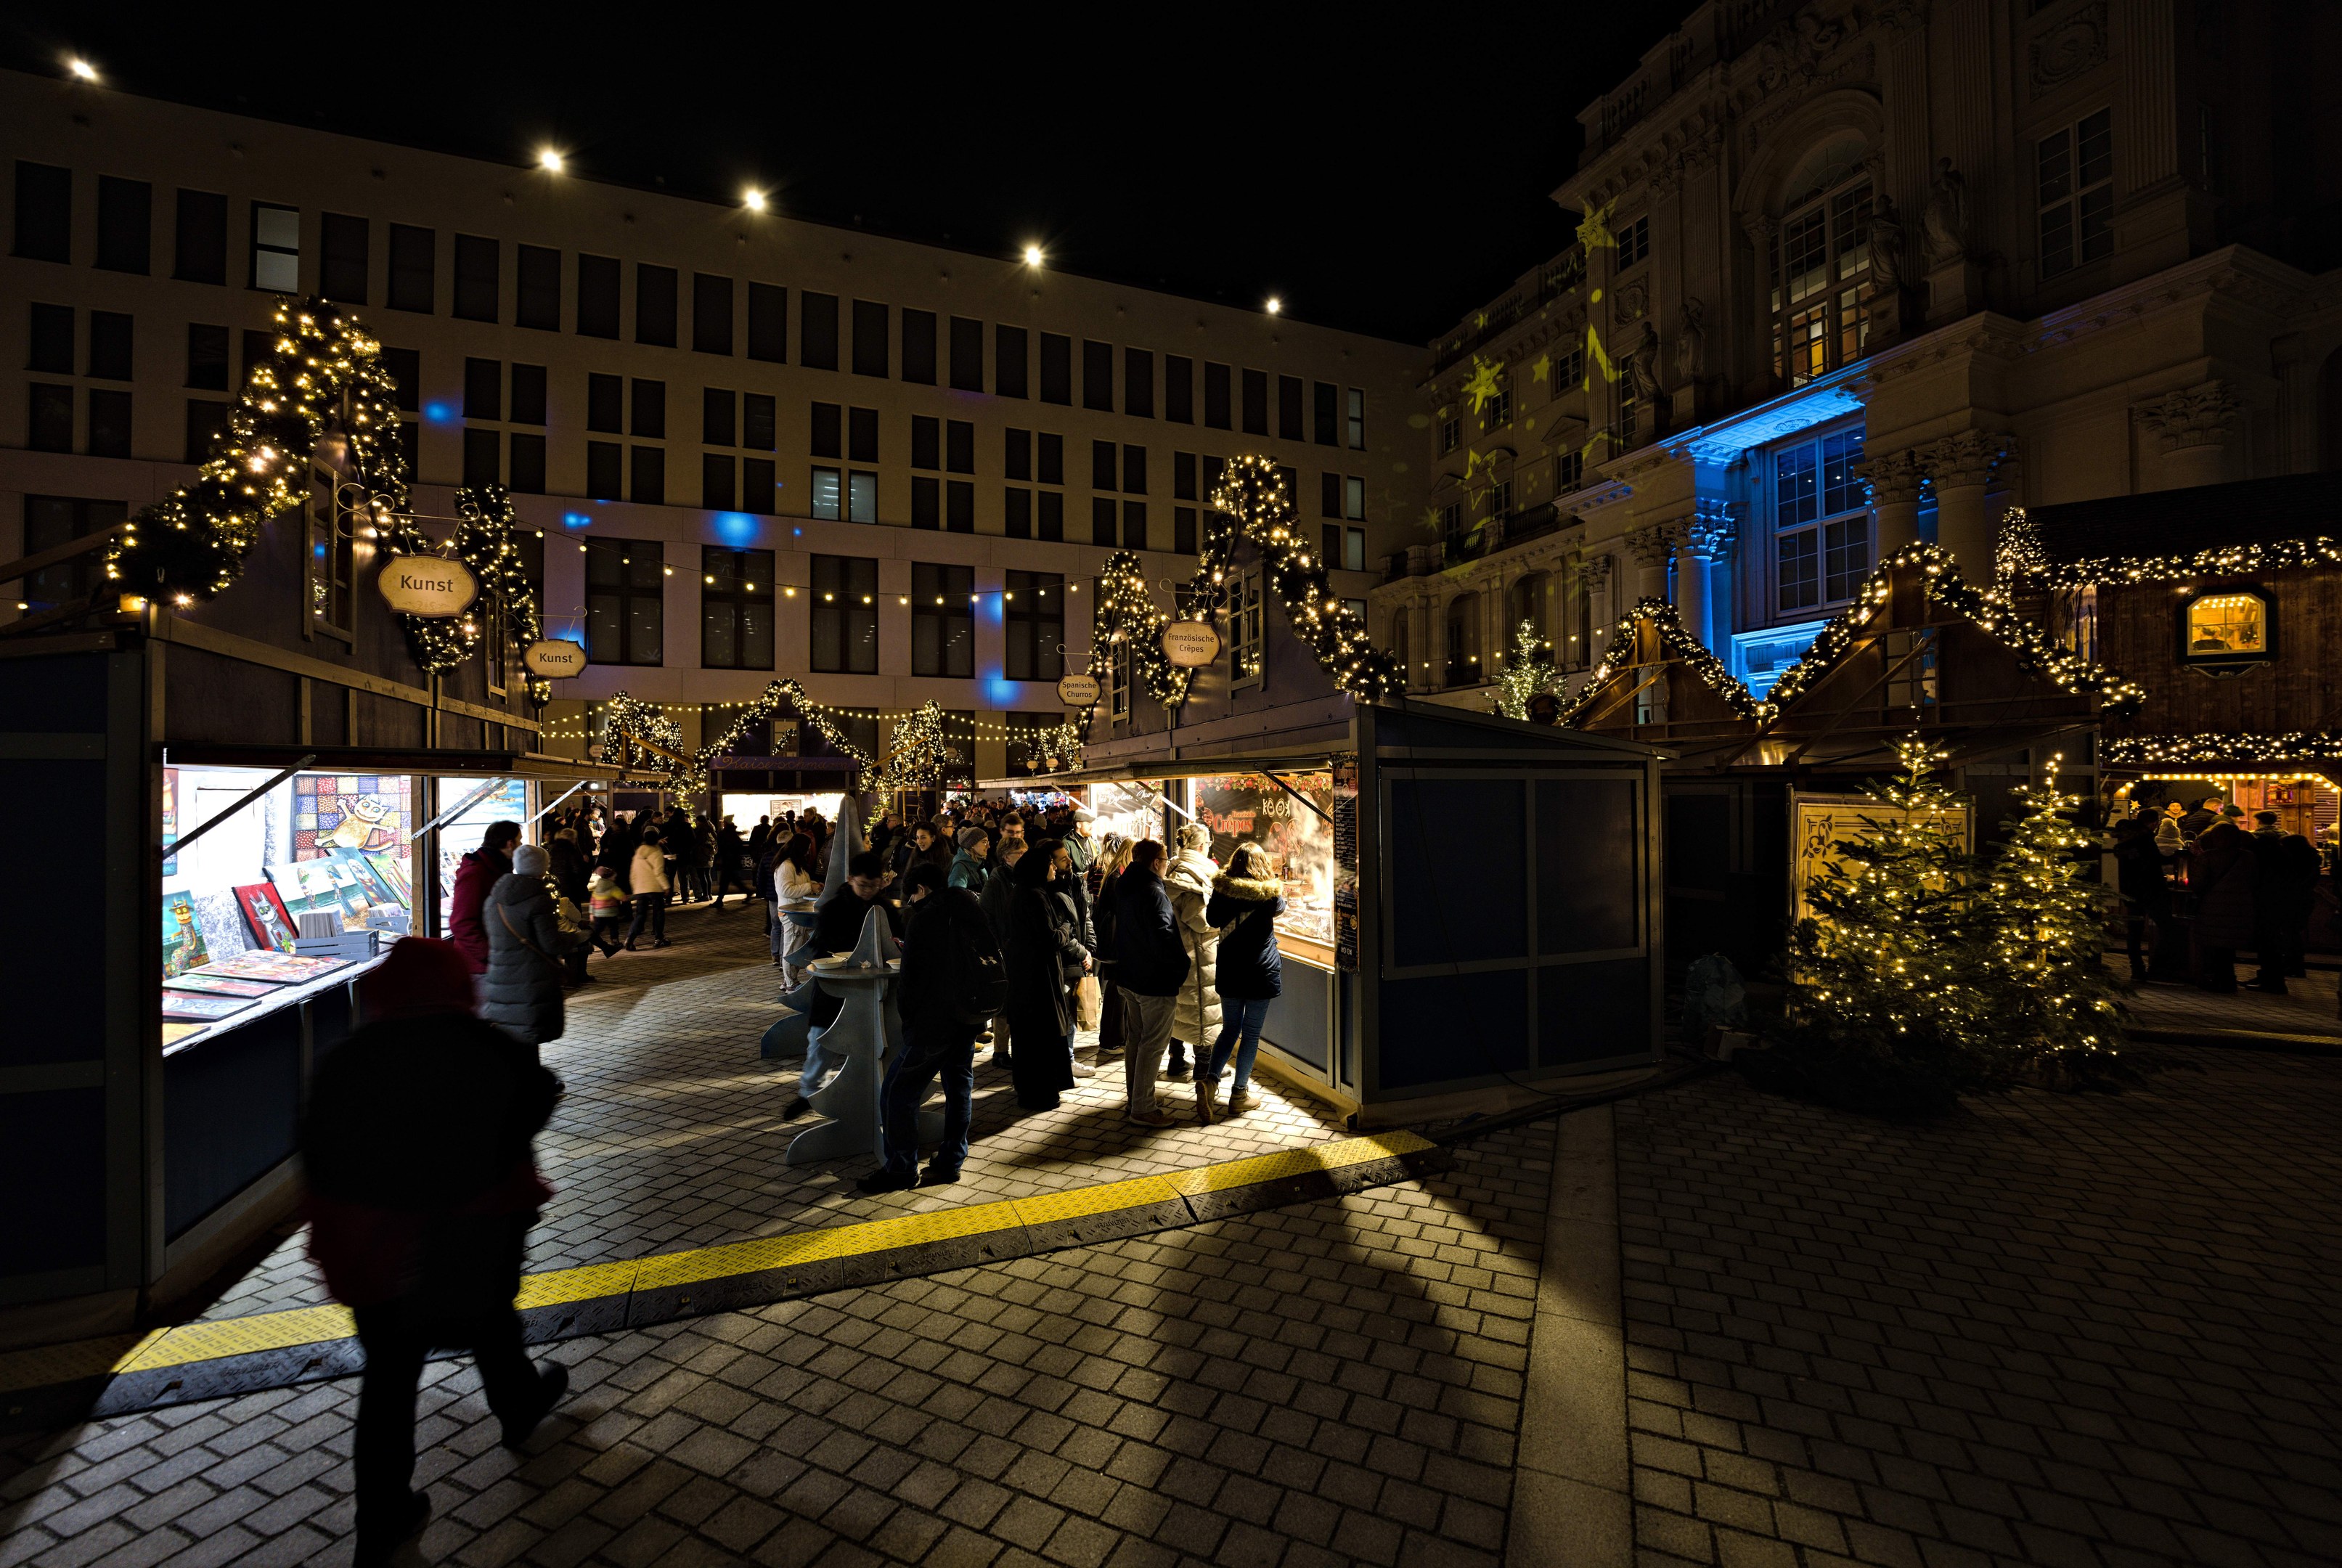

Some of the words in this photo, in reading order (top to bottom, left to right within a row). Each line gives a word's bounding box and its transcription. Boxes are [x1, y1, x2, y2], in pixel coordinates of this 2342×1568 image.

[401, 575, 454, 592] Kunst
[1168, 633, 1215, 642] Französische
[1179, 644, 1204, 653] Crêpes
[539, 653, 573, 663] Kunst
[1213, 814, 1254, 838] Crêpes
